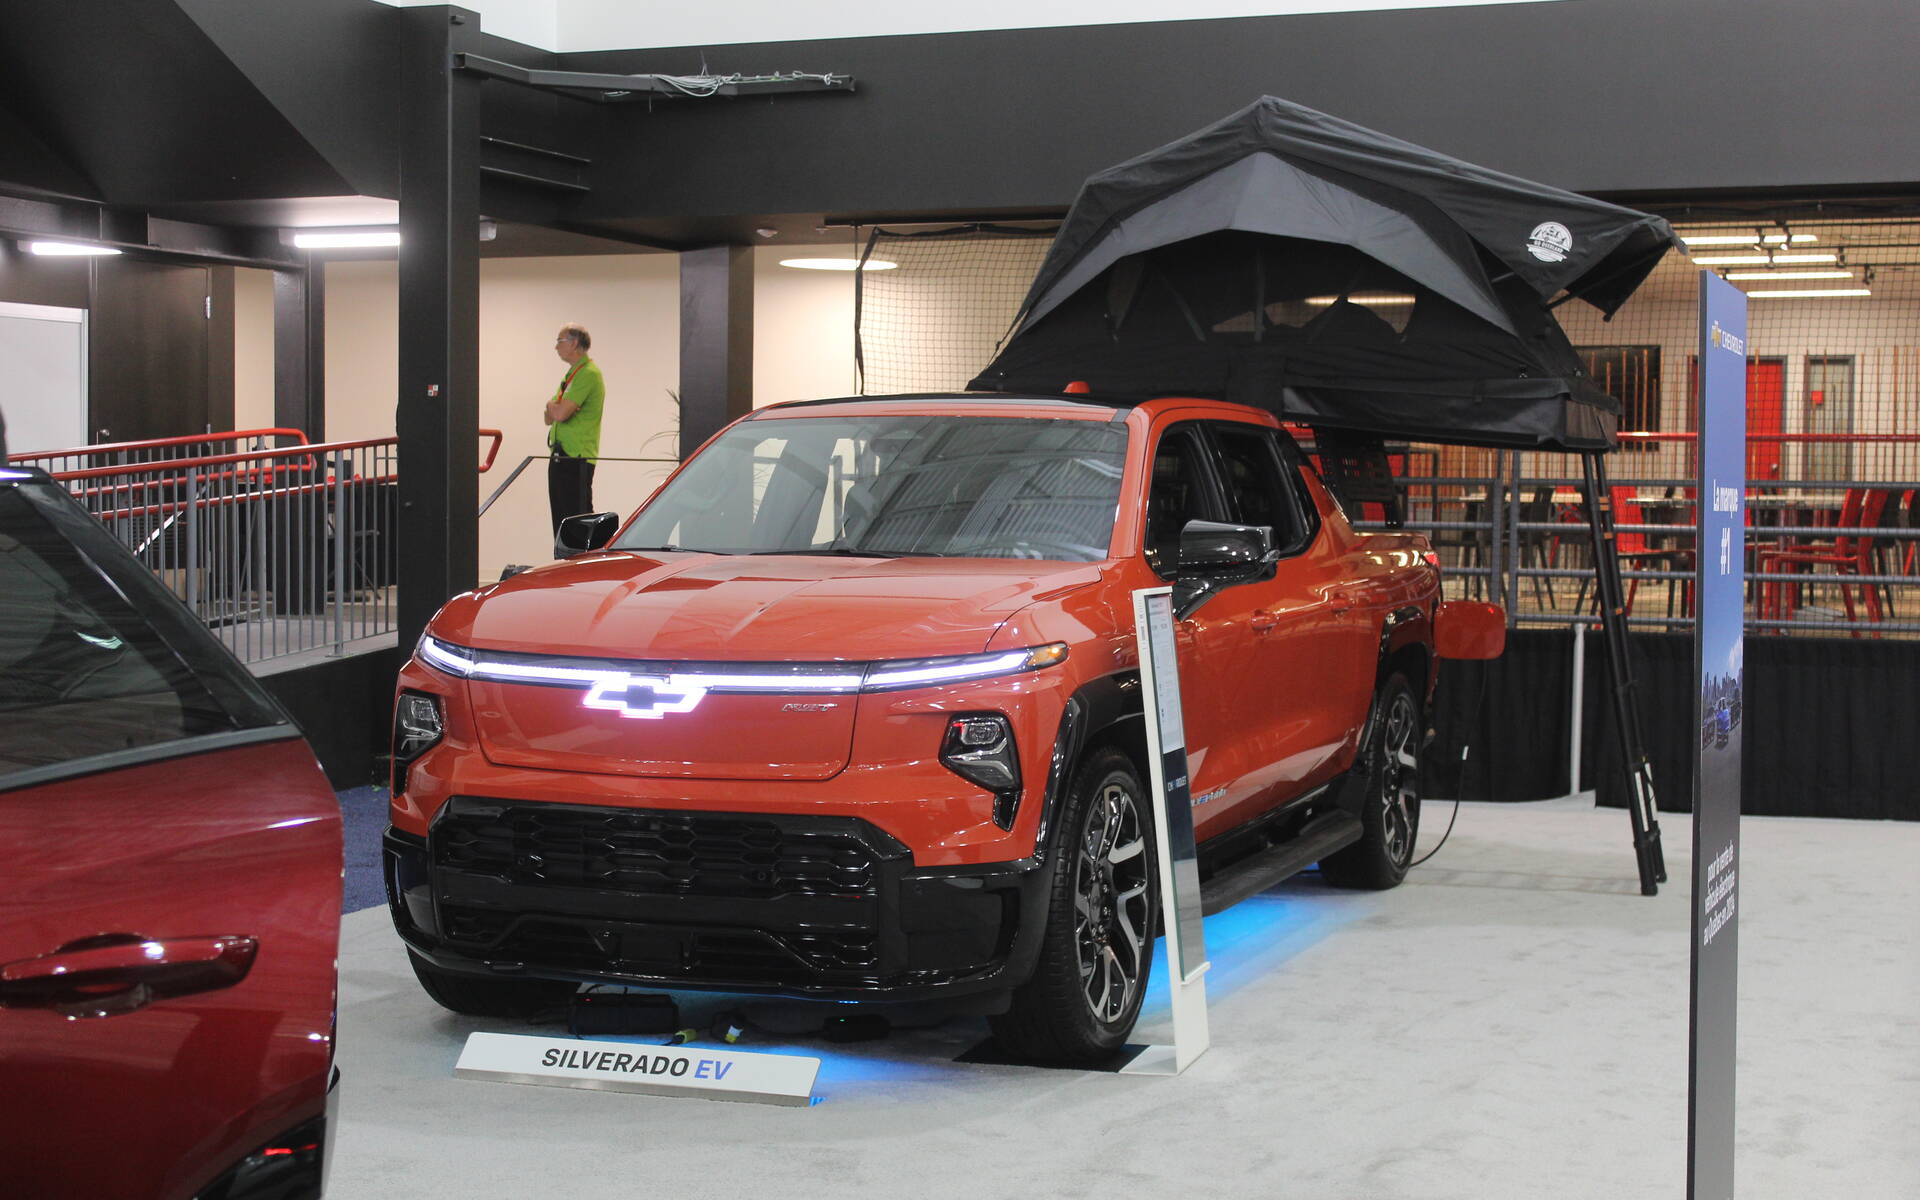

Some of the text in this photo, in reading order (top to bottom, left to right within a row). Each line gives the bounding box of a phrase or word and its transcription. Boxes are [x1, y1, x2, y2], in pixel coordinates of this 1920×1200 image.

[1713, 479, 1738, 519] La marque
[1720, 527, 1731, 576] #1
[541, 1048, 734, 1081] SILVERADO EV
